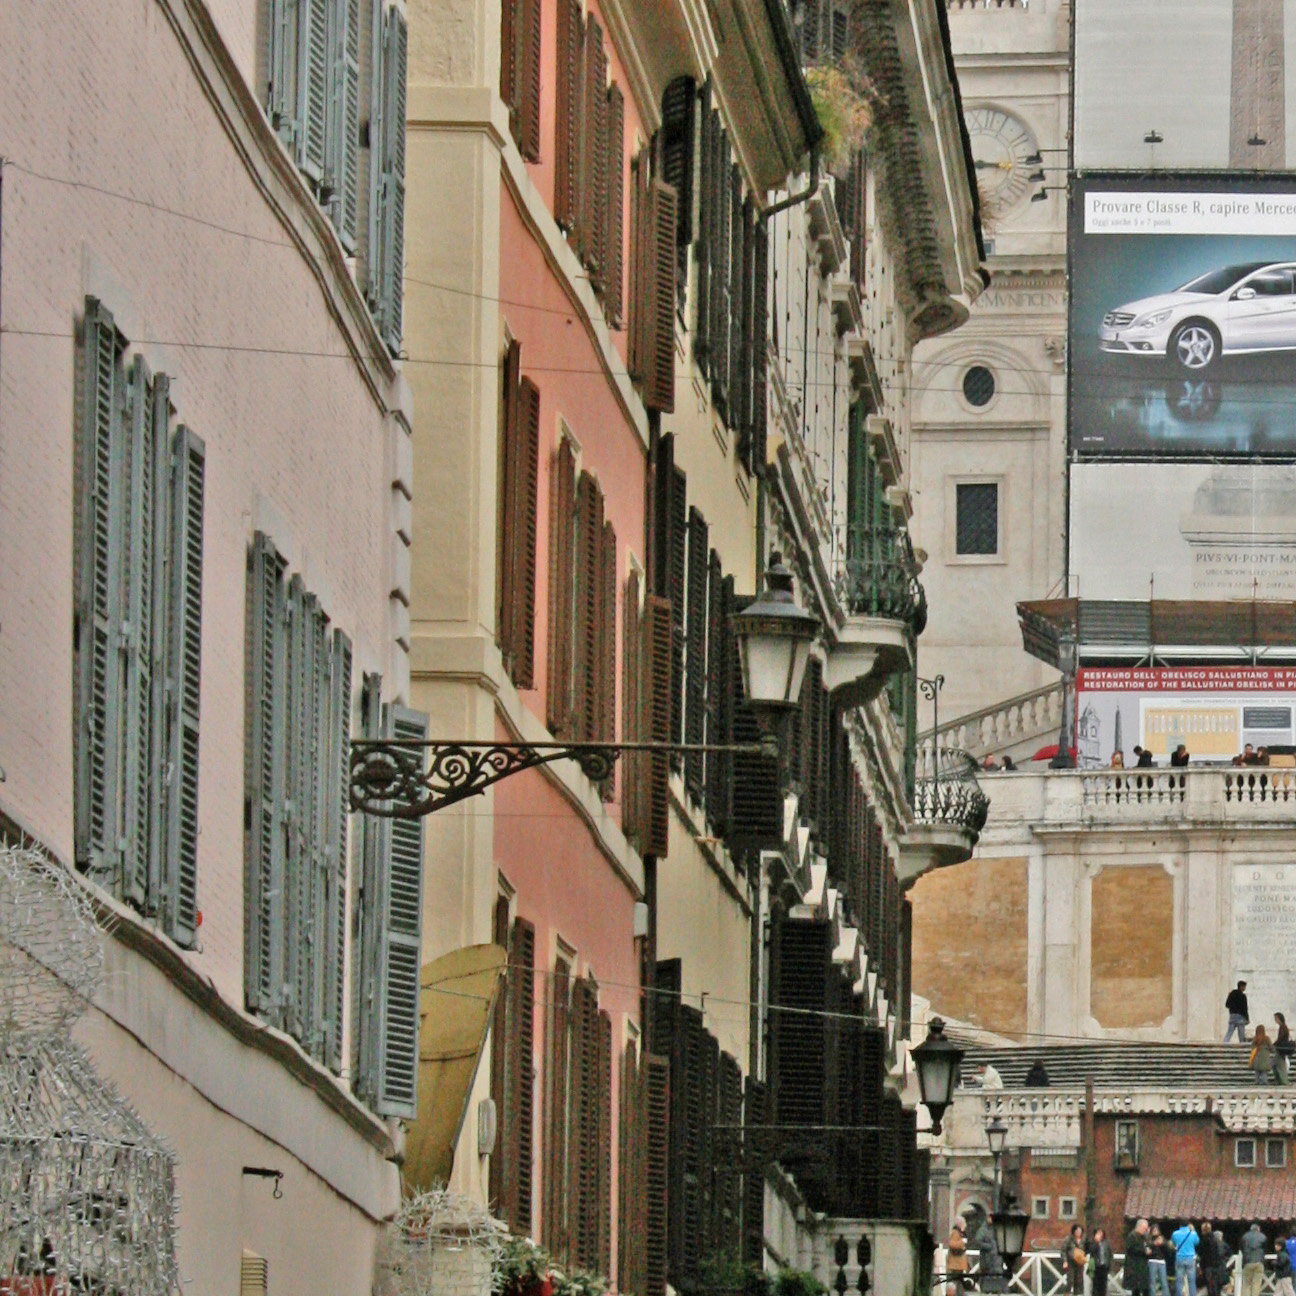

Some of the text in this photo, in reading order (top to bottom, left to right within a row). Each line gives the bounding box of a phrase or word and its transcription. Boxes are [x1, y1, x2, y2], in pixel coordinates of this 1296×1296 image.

[1092, 199, 1142, 214] Provare
[1146, 200, 1188, 214] Classe
[1192, 200, 1205, 215] R,
[1209, 201, 1250, 217] capire
[1083, 671, 1131, 679] RESTAURO
[1161, 671, 1206, 679] OBELISCO
[1208, 671, 1269, 679] SALLUSTIANO
[1274, 671, 1284, 679] IN
[1083, 680, 1144, 689] RESTORATION
[1147, 680, 1159, 689] OF
[1161, 680, 1177, 689] THE
[1180, 680, 1234, 689] SALLUSTIAN
[1236, 680, 1273, 689] OBELISK
[1276, 680, 1286, 688] IN
